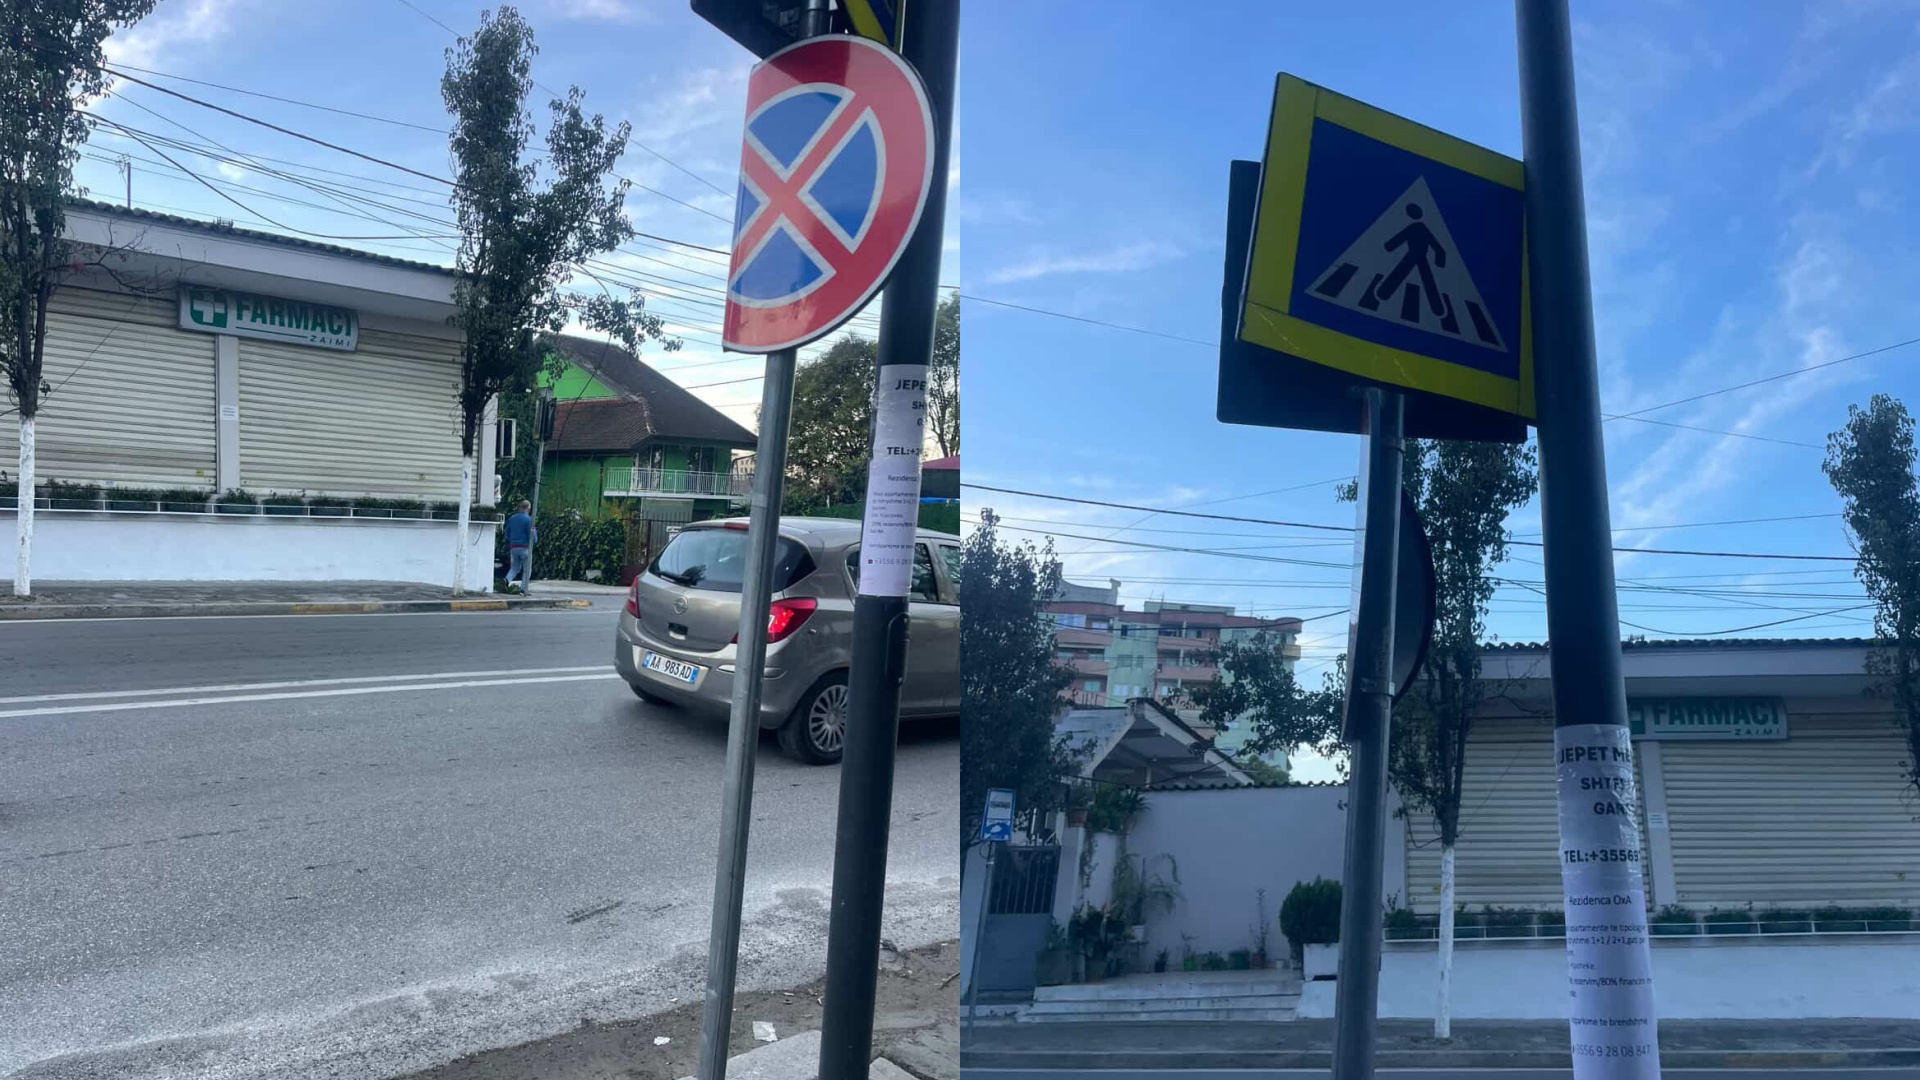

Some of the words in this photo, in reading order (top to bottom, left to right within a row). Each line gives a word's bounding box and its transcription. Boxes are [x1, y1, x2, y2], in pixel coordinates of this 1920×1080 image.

[236, 297, 351, 336] FARMACI
[309, 335, 351, 347] ZAIMI
[650, 655, 661, 669] AA
[664, 660, 680, 675] 983
[680, 665, 692, 679] AD
[1654, 700, 1780, 725] FARMACI
[1735, 728, 1780, 736] ZAIMI
[1560, 746, 1608, 764] JEPET
[1596, 1045, 1603, 1057] 9
[1605, 1045, 1619, 1057] 28
[1620, 1045, 1634, 1057] 08
